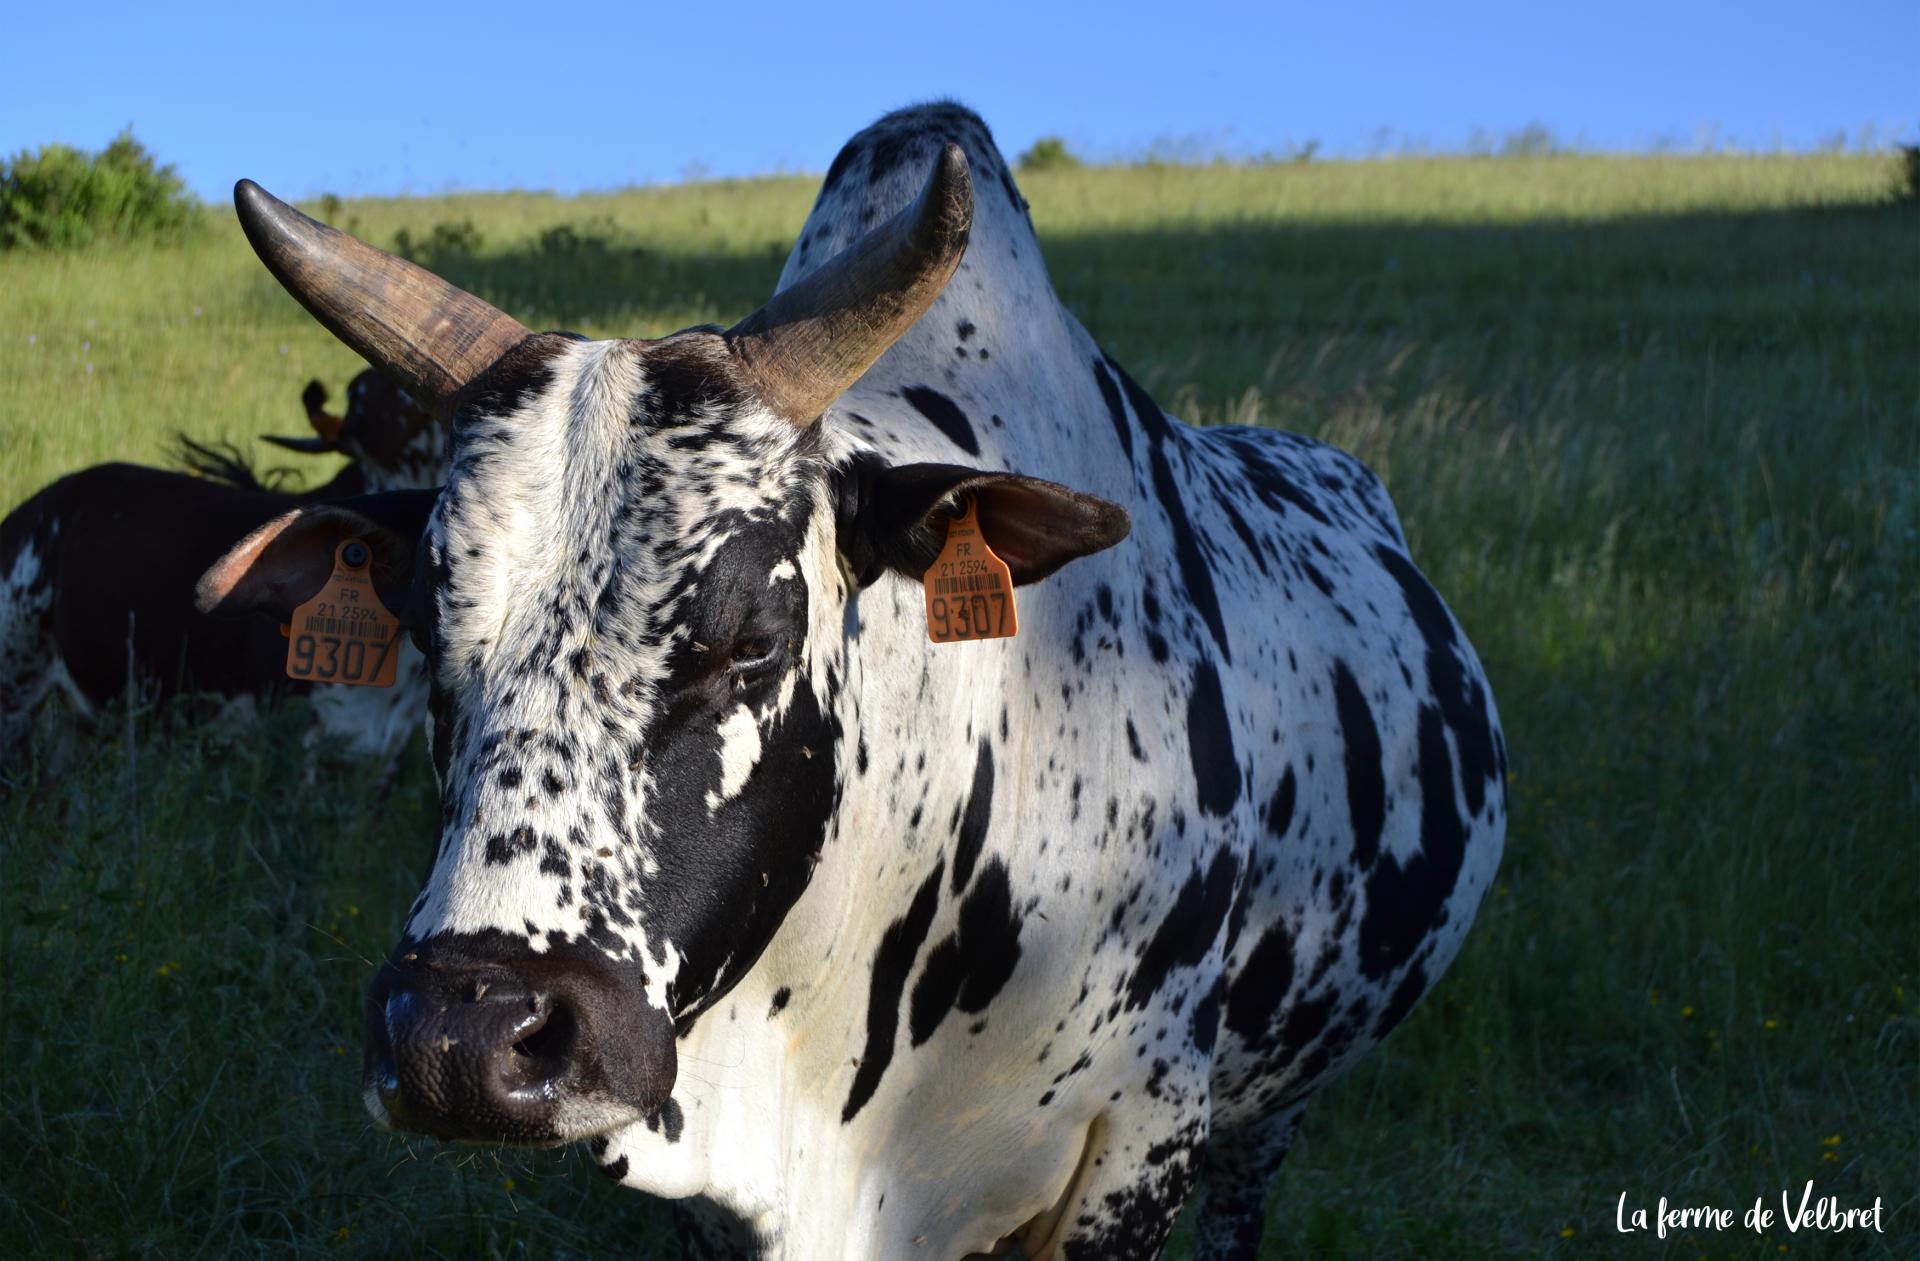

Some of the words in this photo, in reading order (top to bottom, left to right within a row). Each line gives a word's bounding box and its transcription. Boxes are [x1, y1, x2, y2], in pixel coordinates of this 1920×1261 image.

[956, 543, 971, 556] FR
[941, 562, 955, 576] 21
[960, 560, 988, 575] 2594
[340, 588, 360, 603] FR
[318, 603, 336, 616] 21
[341, 606, 377, 622] 2594
[932, 592, 1007, 638] 9307
[292, 634, 391, 683] 9307
